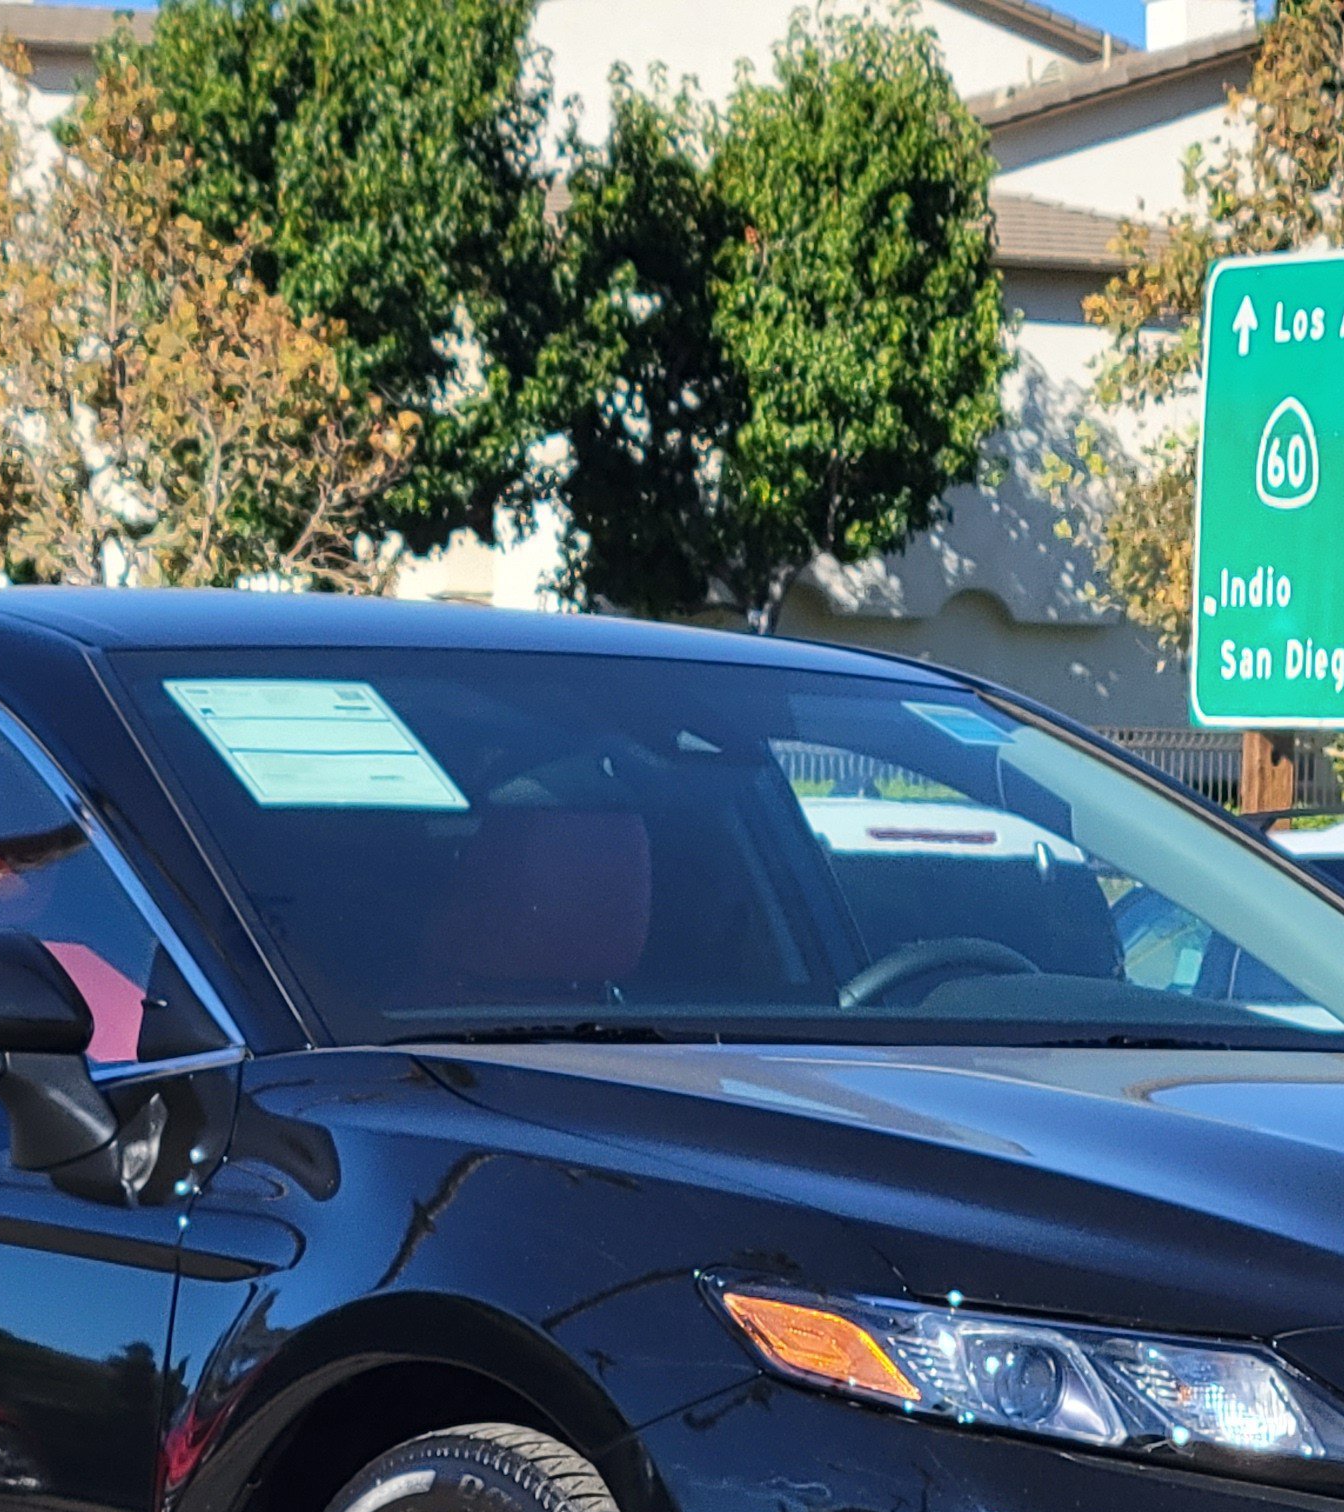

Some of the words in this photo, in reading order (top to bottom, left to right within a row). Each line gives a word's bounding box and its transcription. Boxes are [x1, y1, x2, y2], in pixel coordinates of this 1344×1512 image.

[1273, 301, 1326, 344] Los
[1266, 433, 1307, 490] 60
[1219, 566, 1292, 609] Indio
[1219, 639, 1273, 681] San
